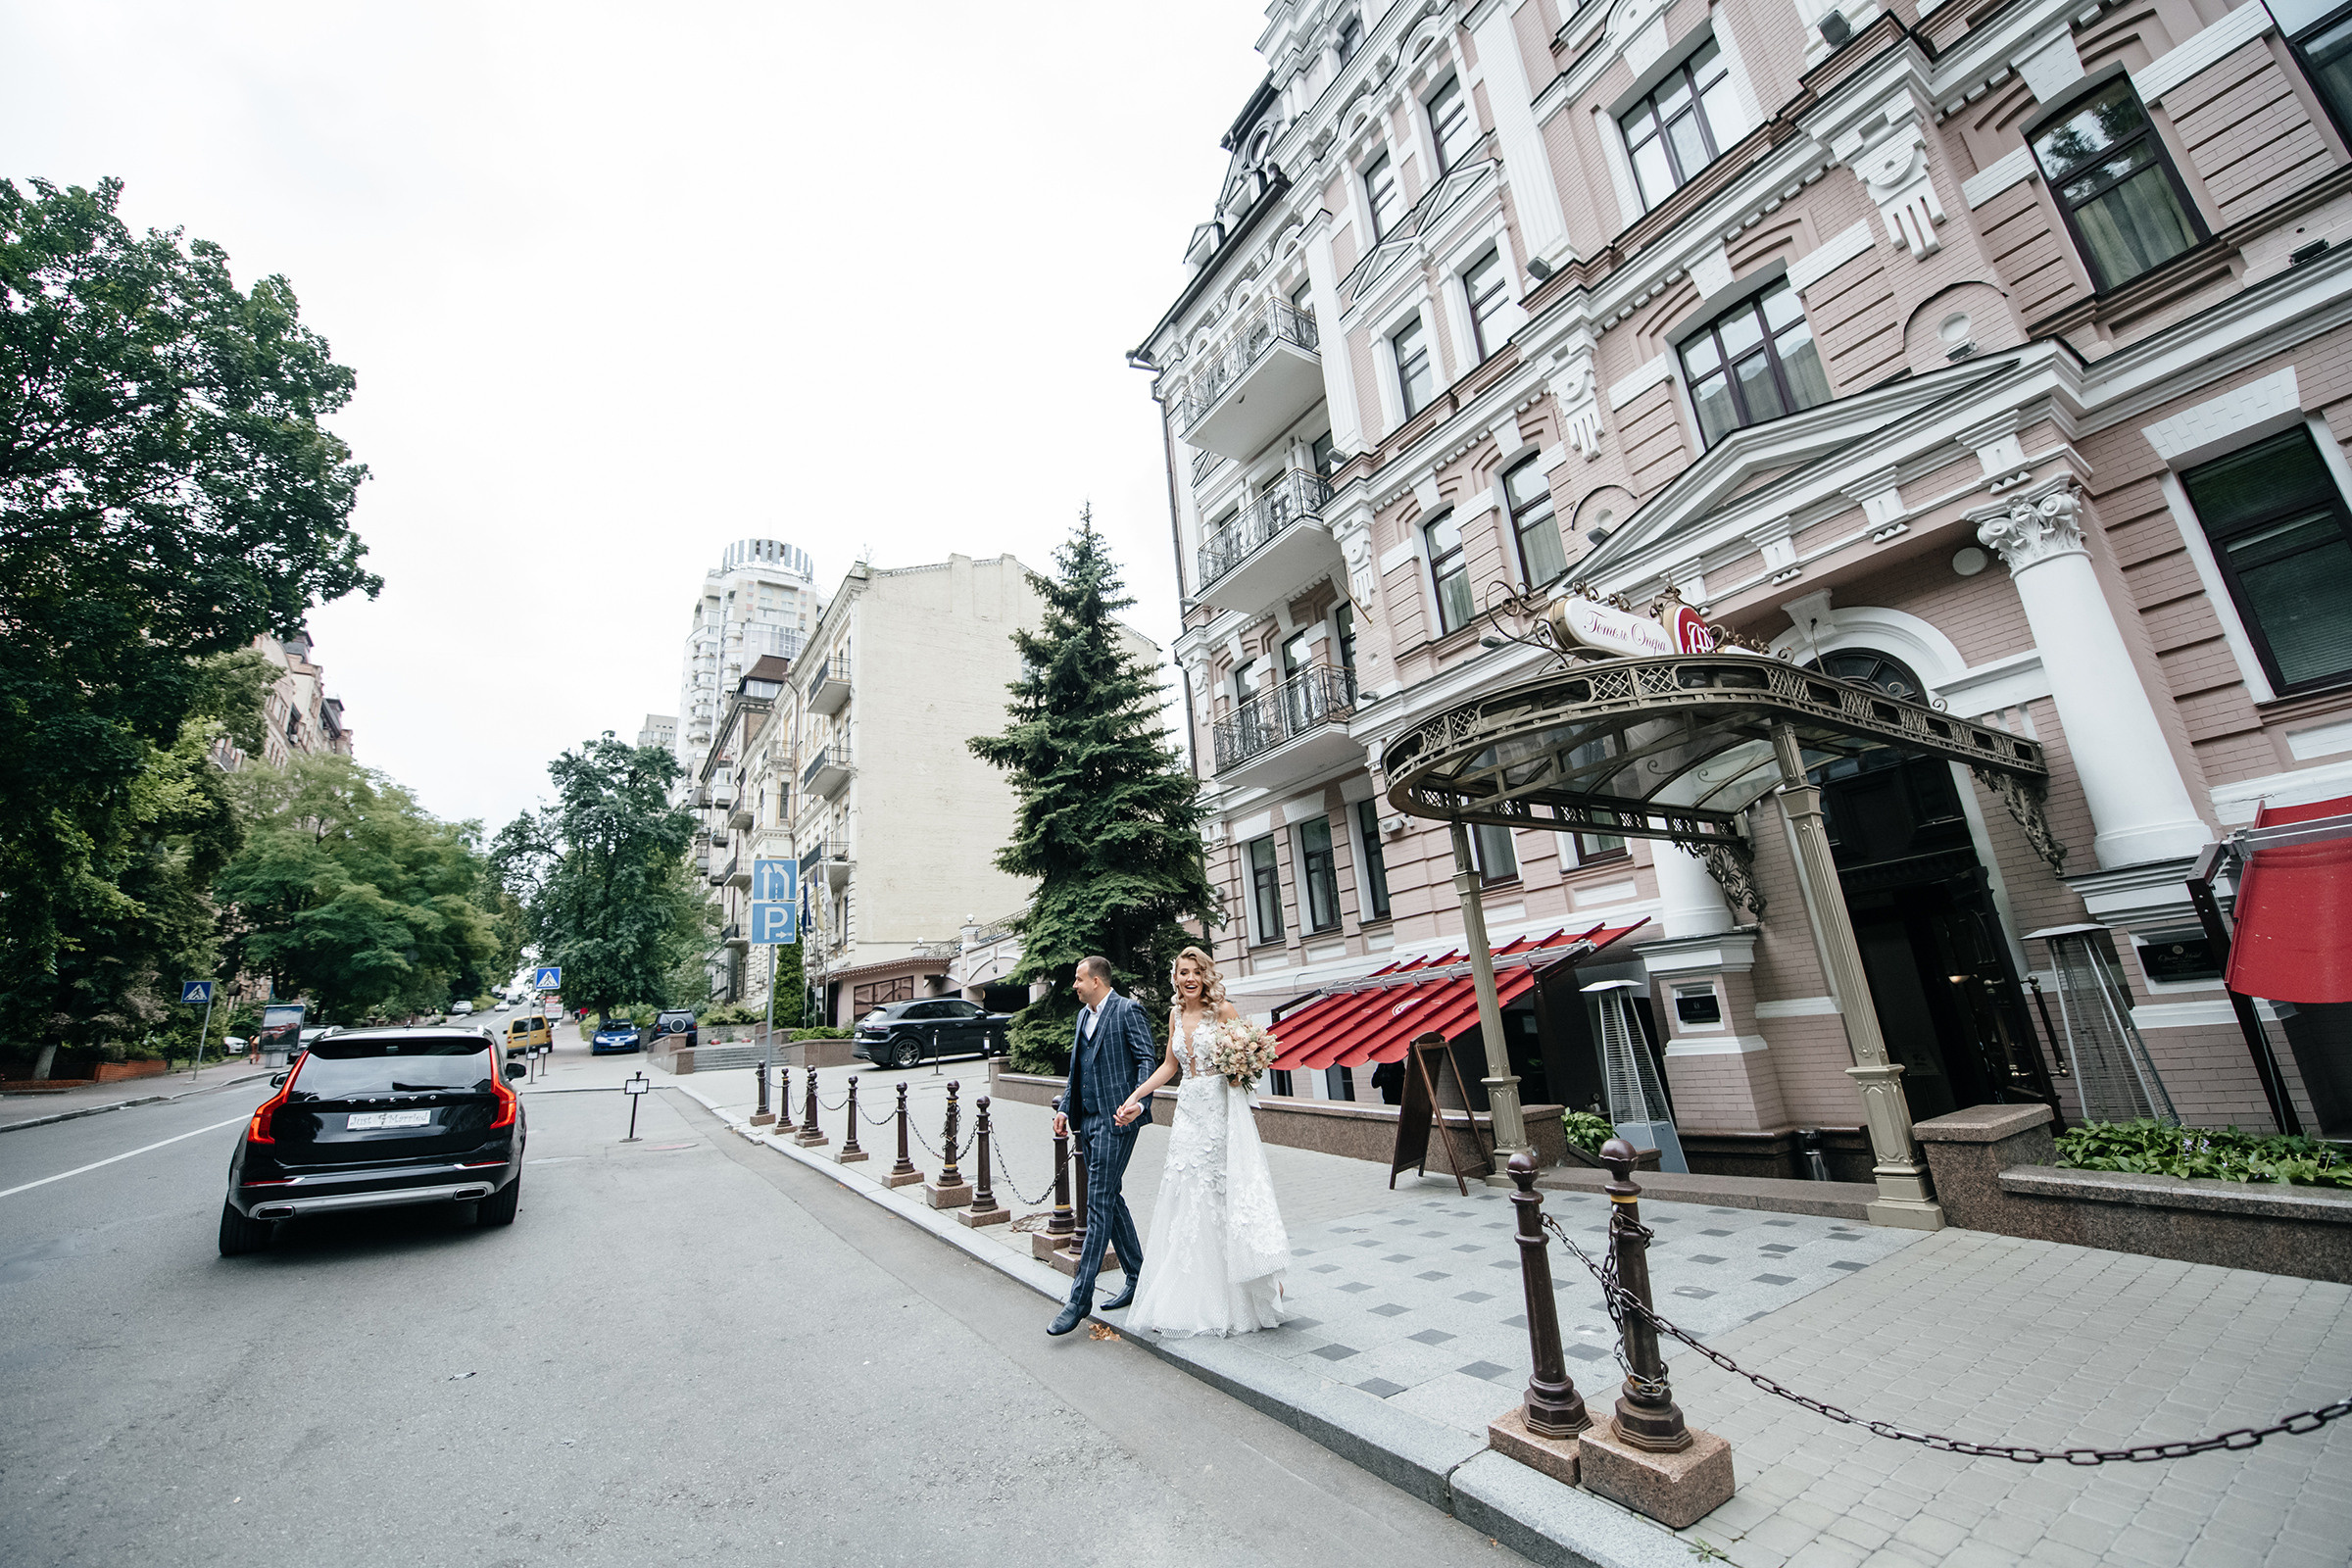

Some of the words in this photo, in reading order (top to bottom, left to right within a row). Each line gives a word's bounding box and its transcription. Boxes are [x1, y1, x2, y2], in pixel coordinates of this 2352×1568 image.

[1583, 610, 1627, 640] Готель
[1631, 622, 1665, 656] Опера
[764, 906, 789, 940] P
[347, 1095, 436, 1104] VOLVO
[349, 1116, 372, 1126] Just
[388, 1111, 428, 1124] Married
